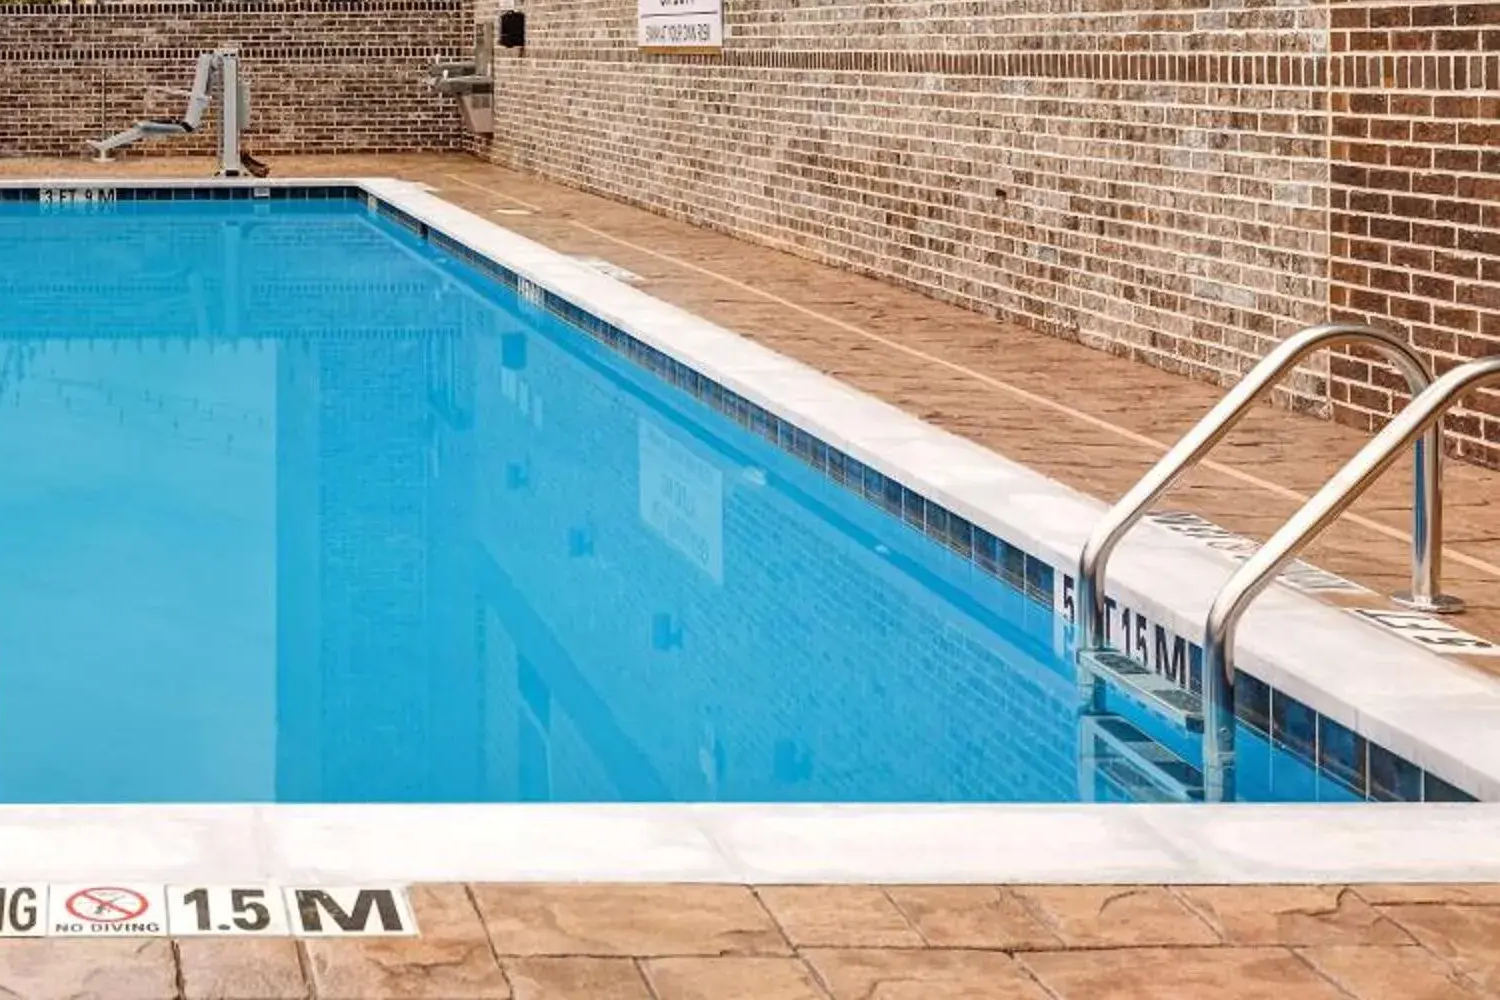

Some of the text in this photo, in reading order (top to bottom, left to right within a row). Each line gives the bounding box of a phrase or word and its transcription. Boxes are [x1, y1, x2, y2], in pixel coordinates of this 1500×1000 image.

[60, 189, 76, 201] FT
[1064, 574, 1075, 625] 5
[1155, 624, 1186, 689] M
[183, 887, 271, 931] 1.5
[295, 889, 404, 932] M
[55, 922, 160, 933] NO DIVING
